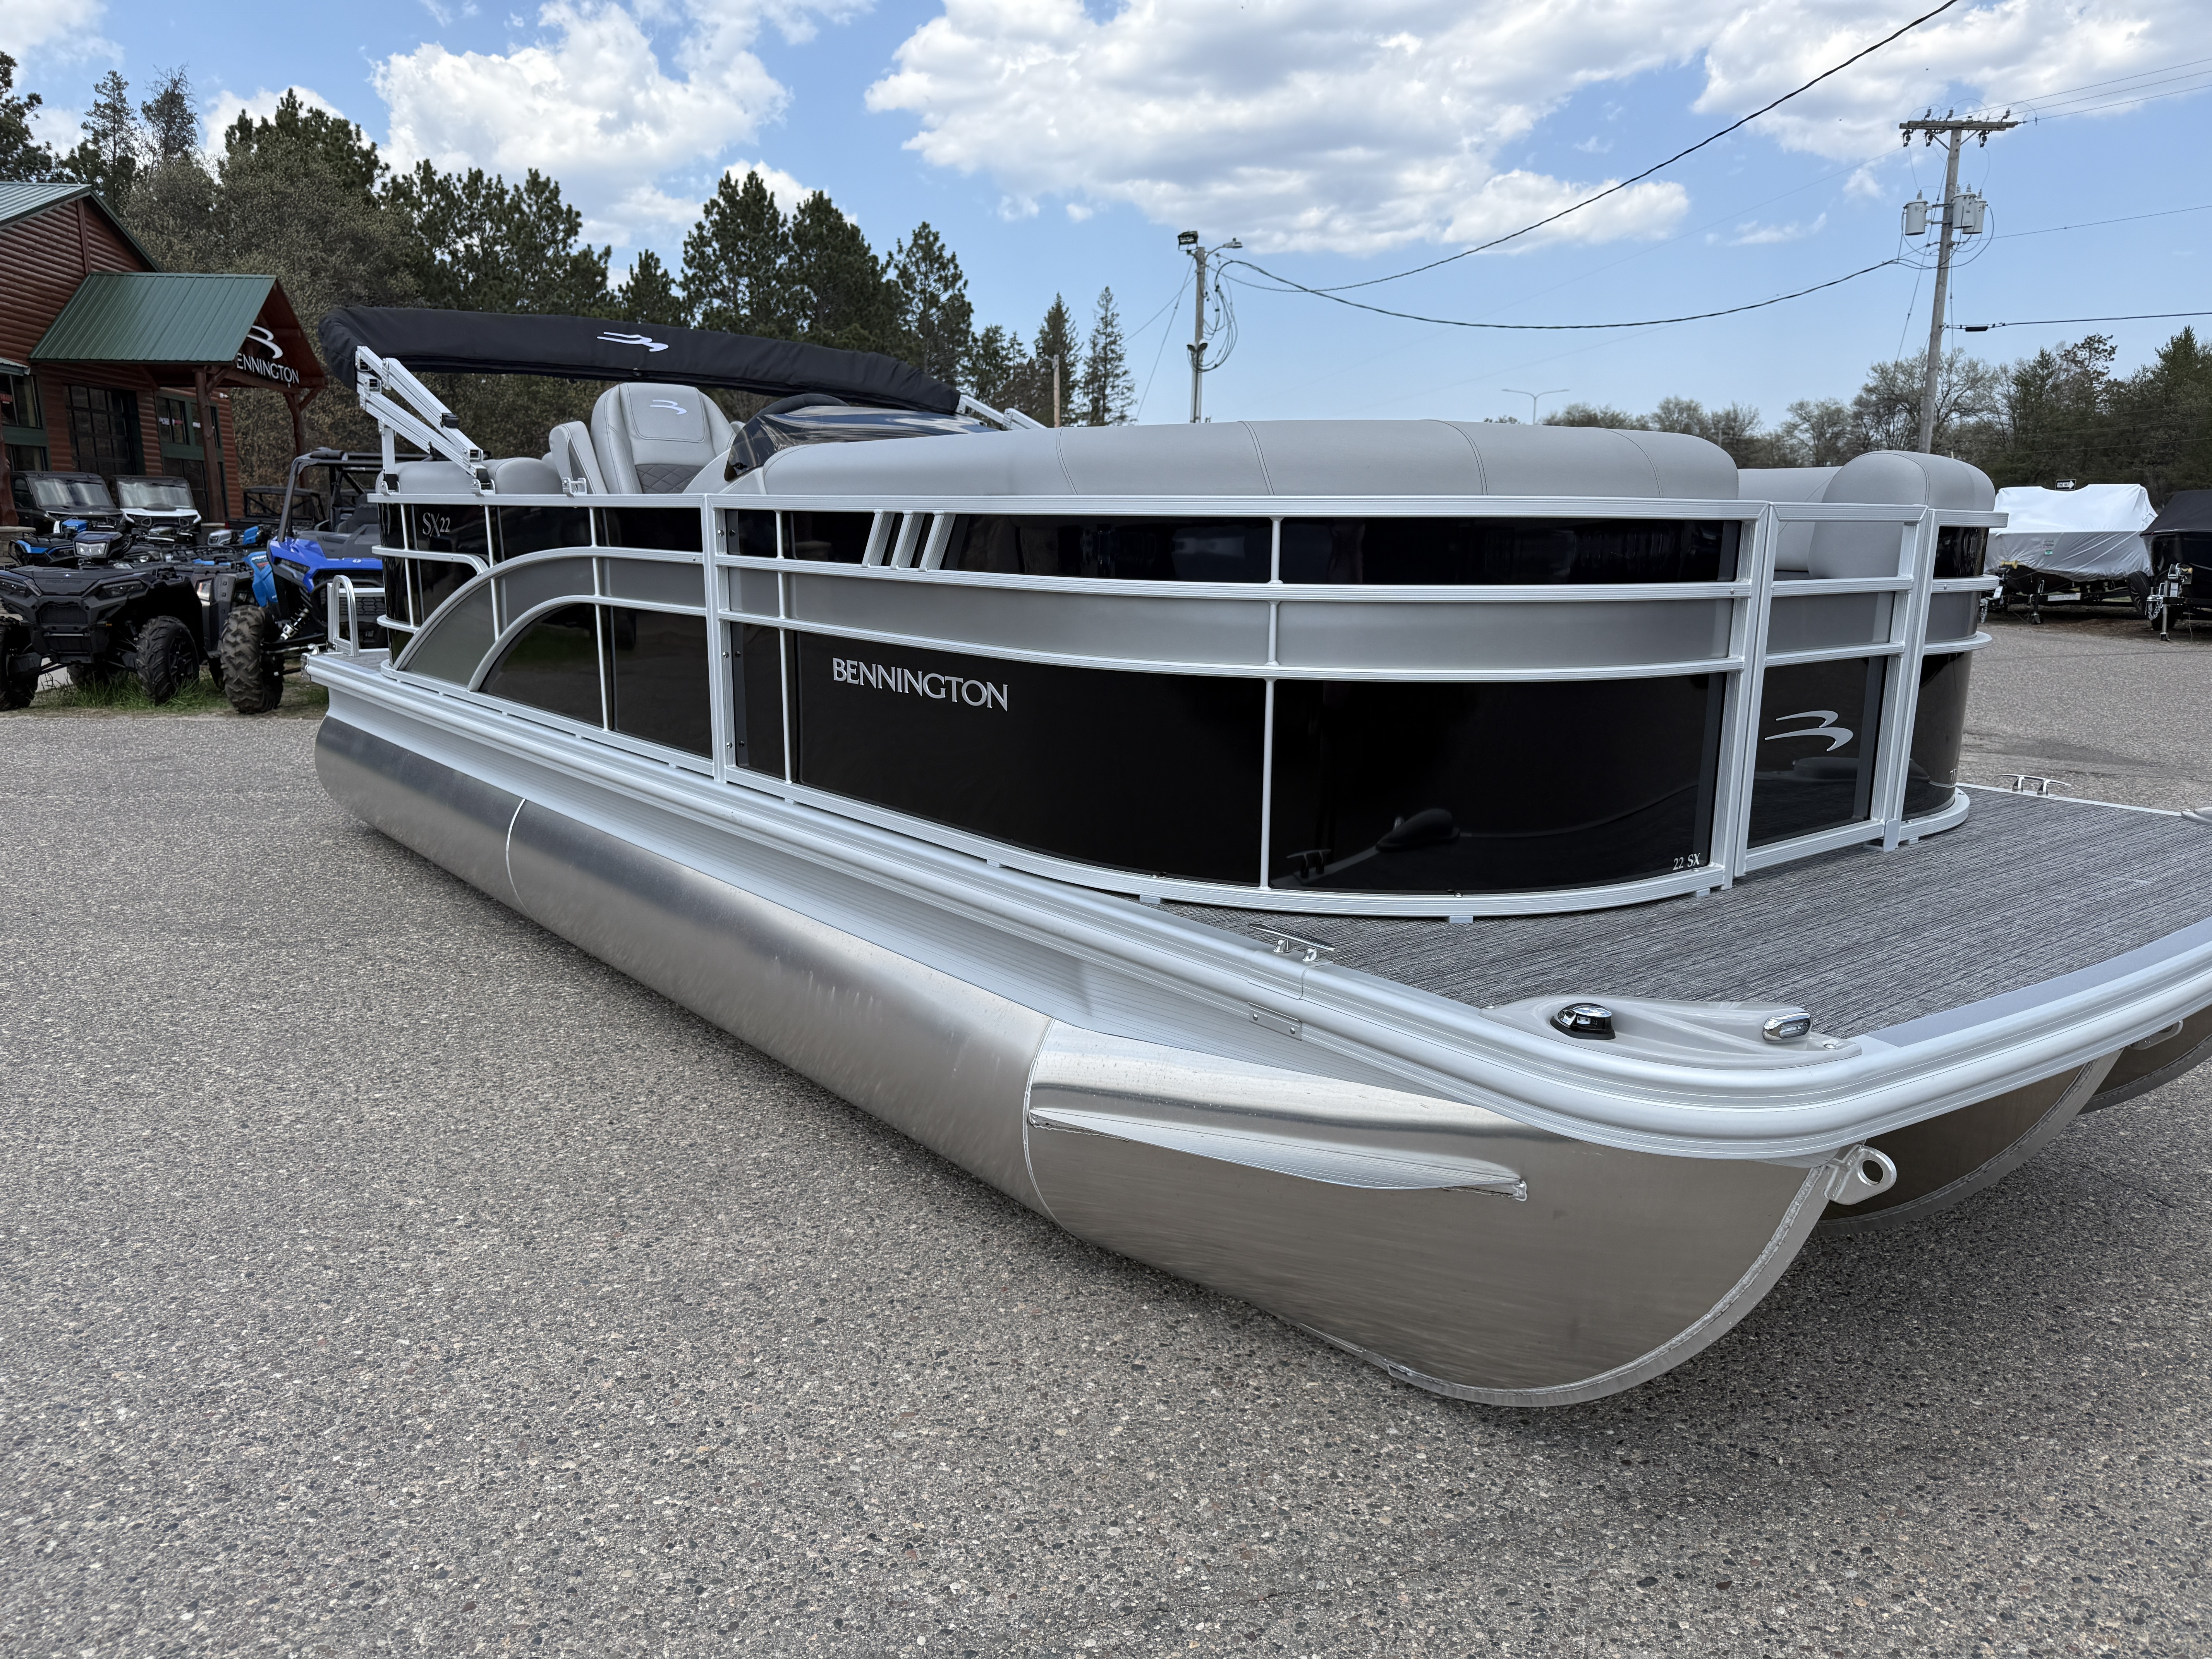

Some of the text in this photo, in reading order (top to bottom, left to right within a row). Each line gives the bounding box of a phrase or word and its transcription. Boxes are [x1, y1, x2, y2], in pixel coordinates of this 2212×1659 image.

[236, 352, 299, 384] ENNINGTON
[832, 657, 1008, 713] BENNINGTON
[1673, 852, 1700, 871] 22 SX
